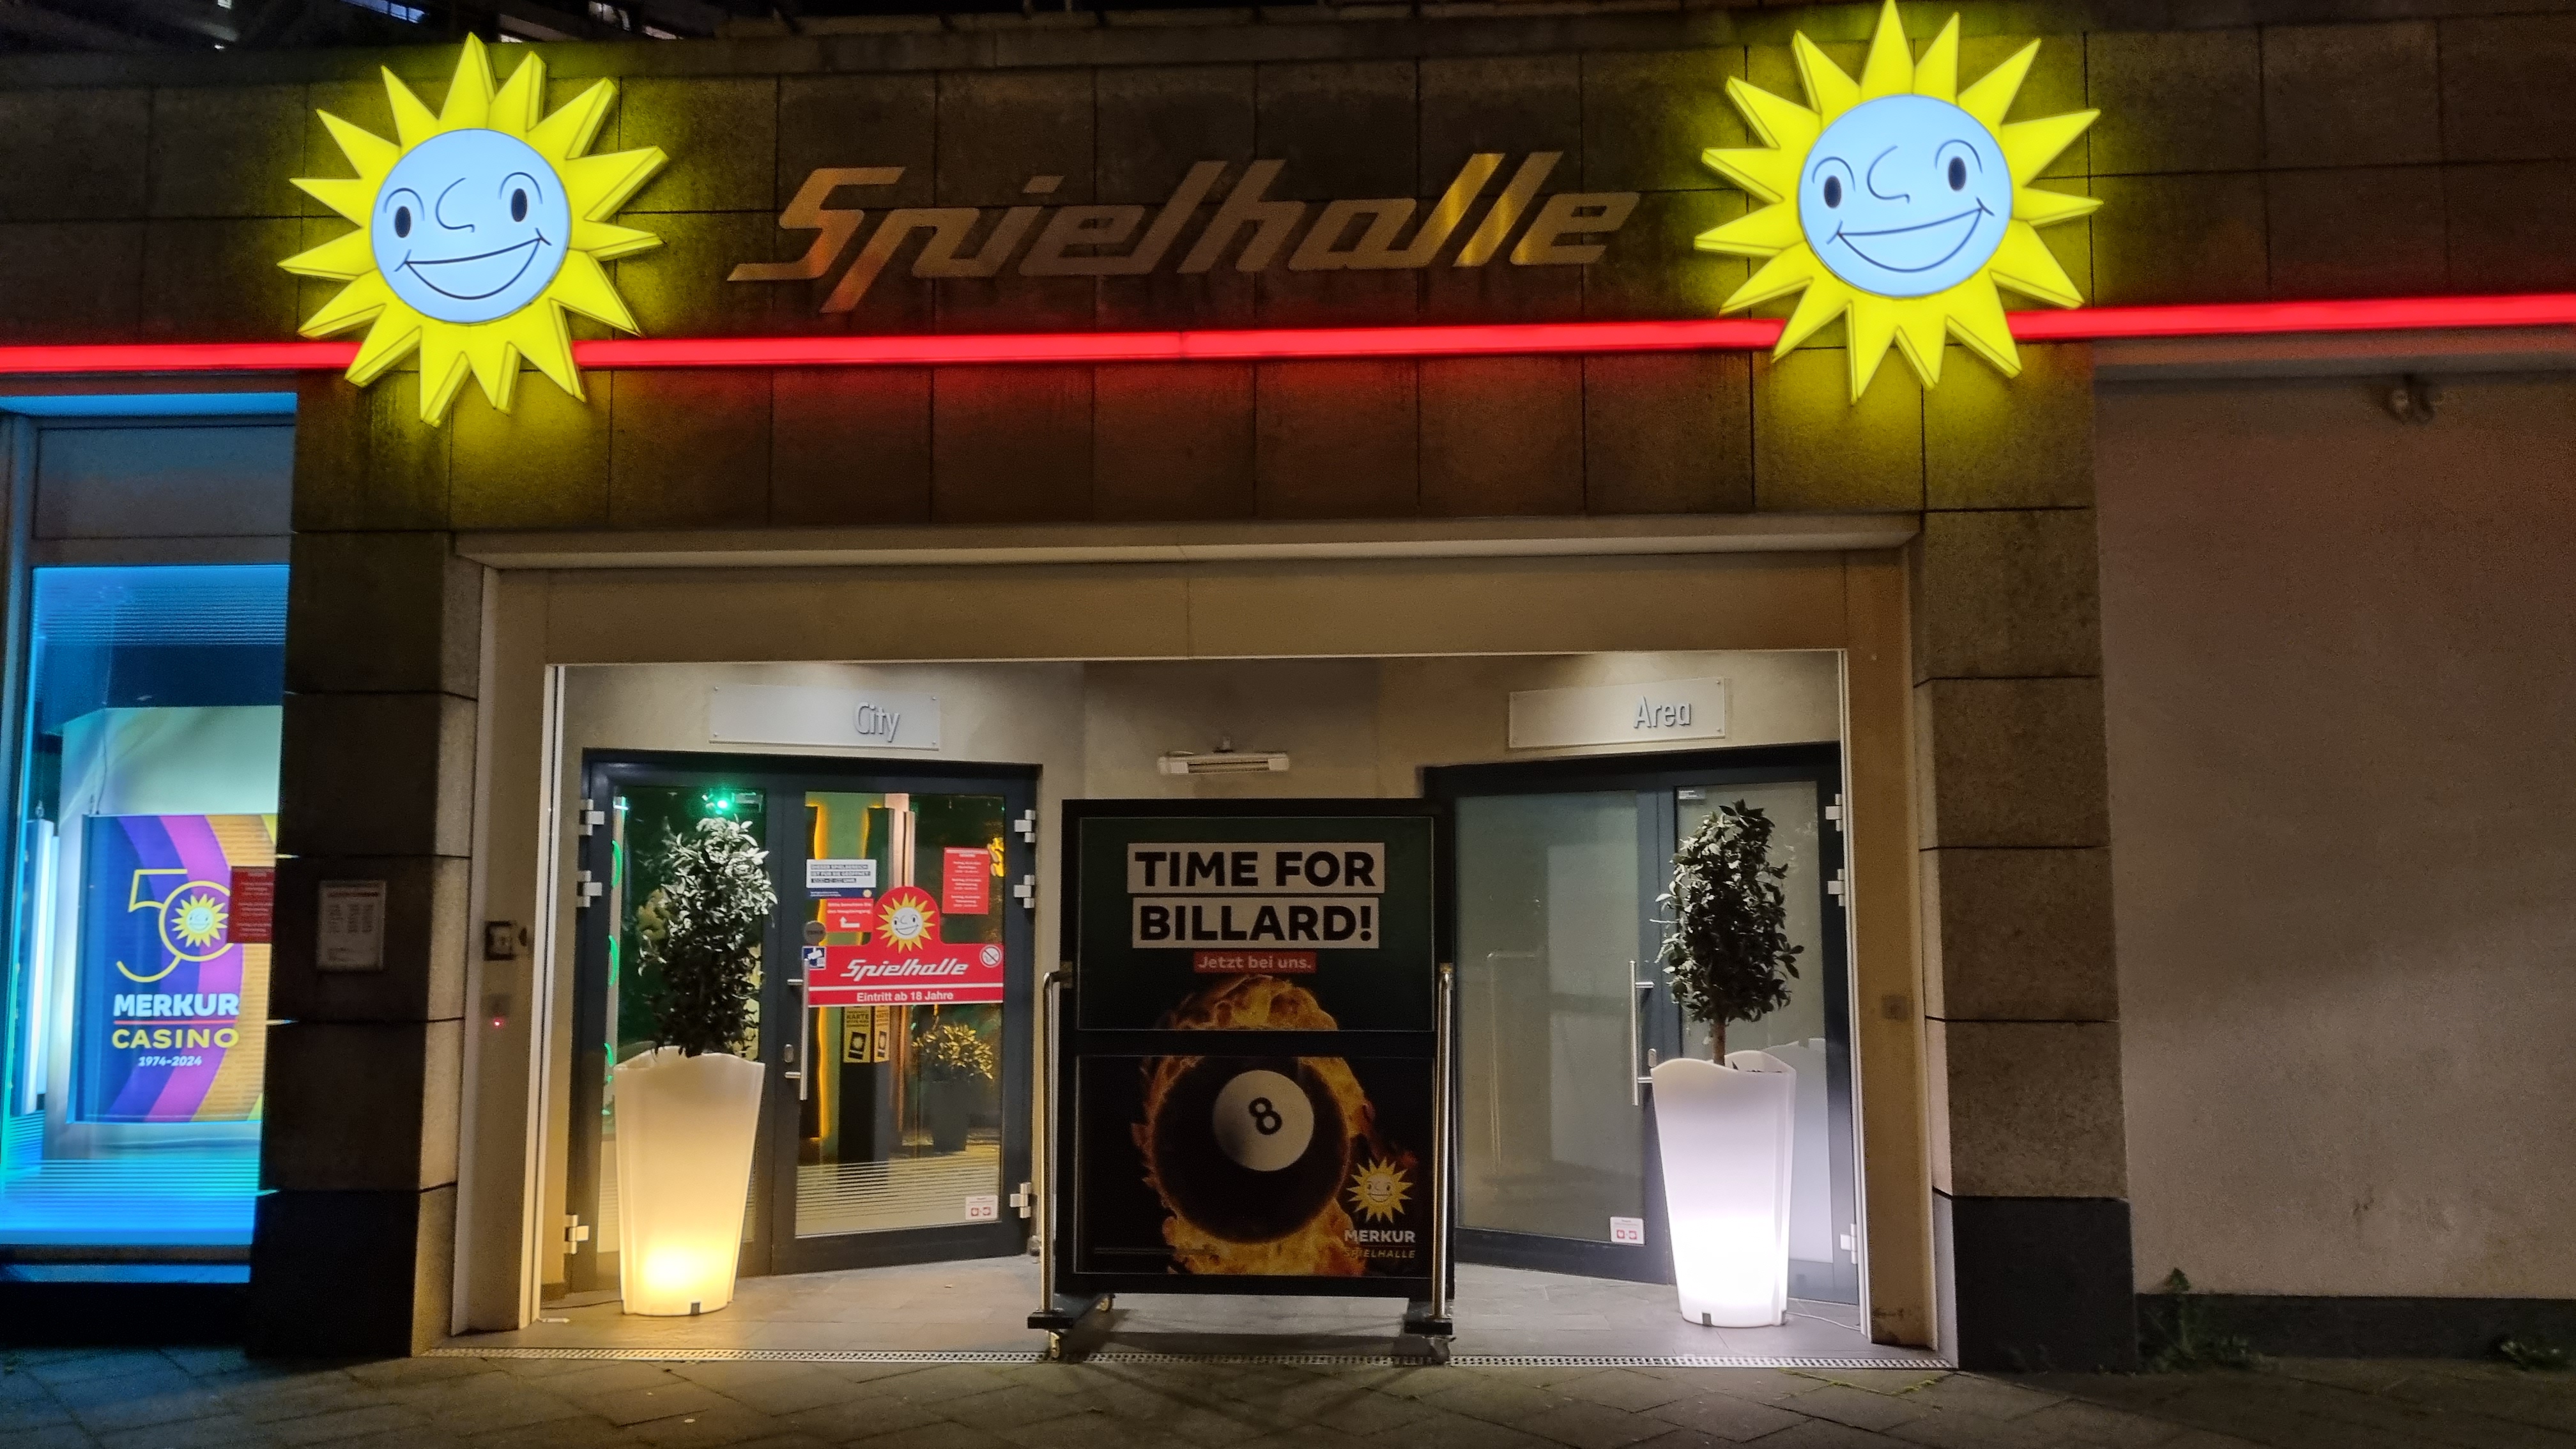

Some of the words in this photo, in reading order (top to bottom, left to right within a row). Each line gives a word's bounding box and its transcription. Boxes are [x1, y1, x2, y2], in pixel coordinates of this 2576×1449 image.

[727, 151, 1640, 313] Spielhalle
[855, 703, 900, 743] City
[1633, 695, 1692, 729] Area
[1135, 851, 1259, 887] TIME
[1275, 851, 1376, 887] FOR
[1140, 905, 1372, 942] BILLARD!
[840, 958, 969, 981] Spielhalle
[1197, 956, 1245, 969] Jetzt
[1248, 955, 1273, 969] bei
[1278, 958, 1312, 969] uns.
[113, 993, 240, 1017] MERKUR
[857, 992, 893, 1002] Eintritt
[894, 992, 907, 1001] ab
[910, 992, 923, 1000] 18
[924, 991, 954, 1000] Jahre
[112, 1028, 240, 1050] CASINO
[138, 1056, 203, 1067] 1974-2024
[1248, 1097, 1283, 1135] 8
[1344, 1229, 1416, 1243] MERKUR
